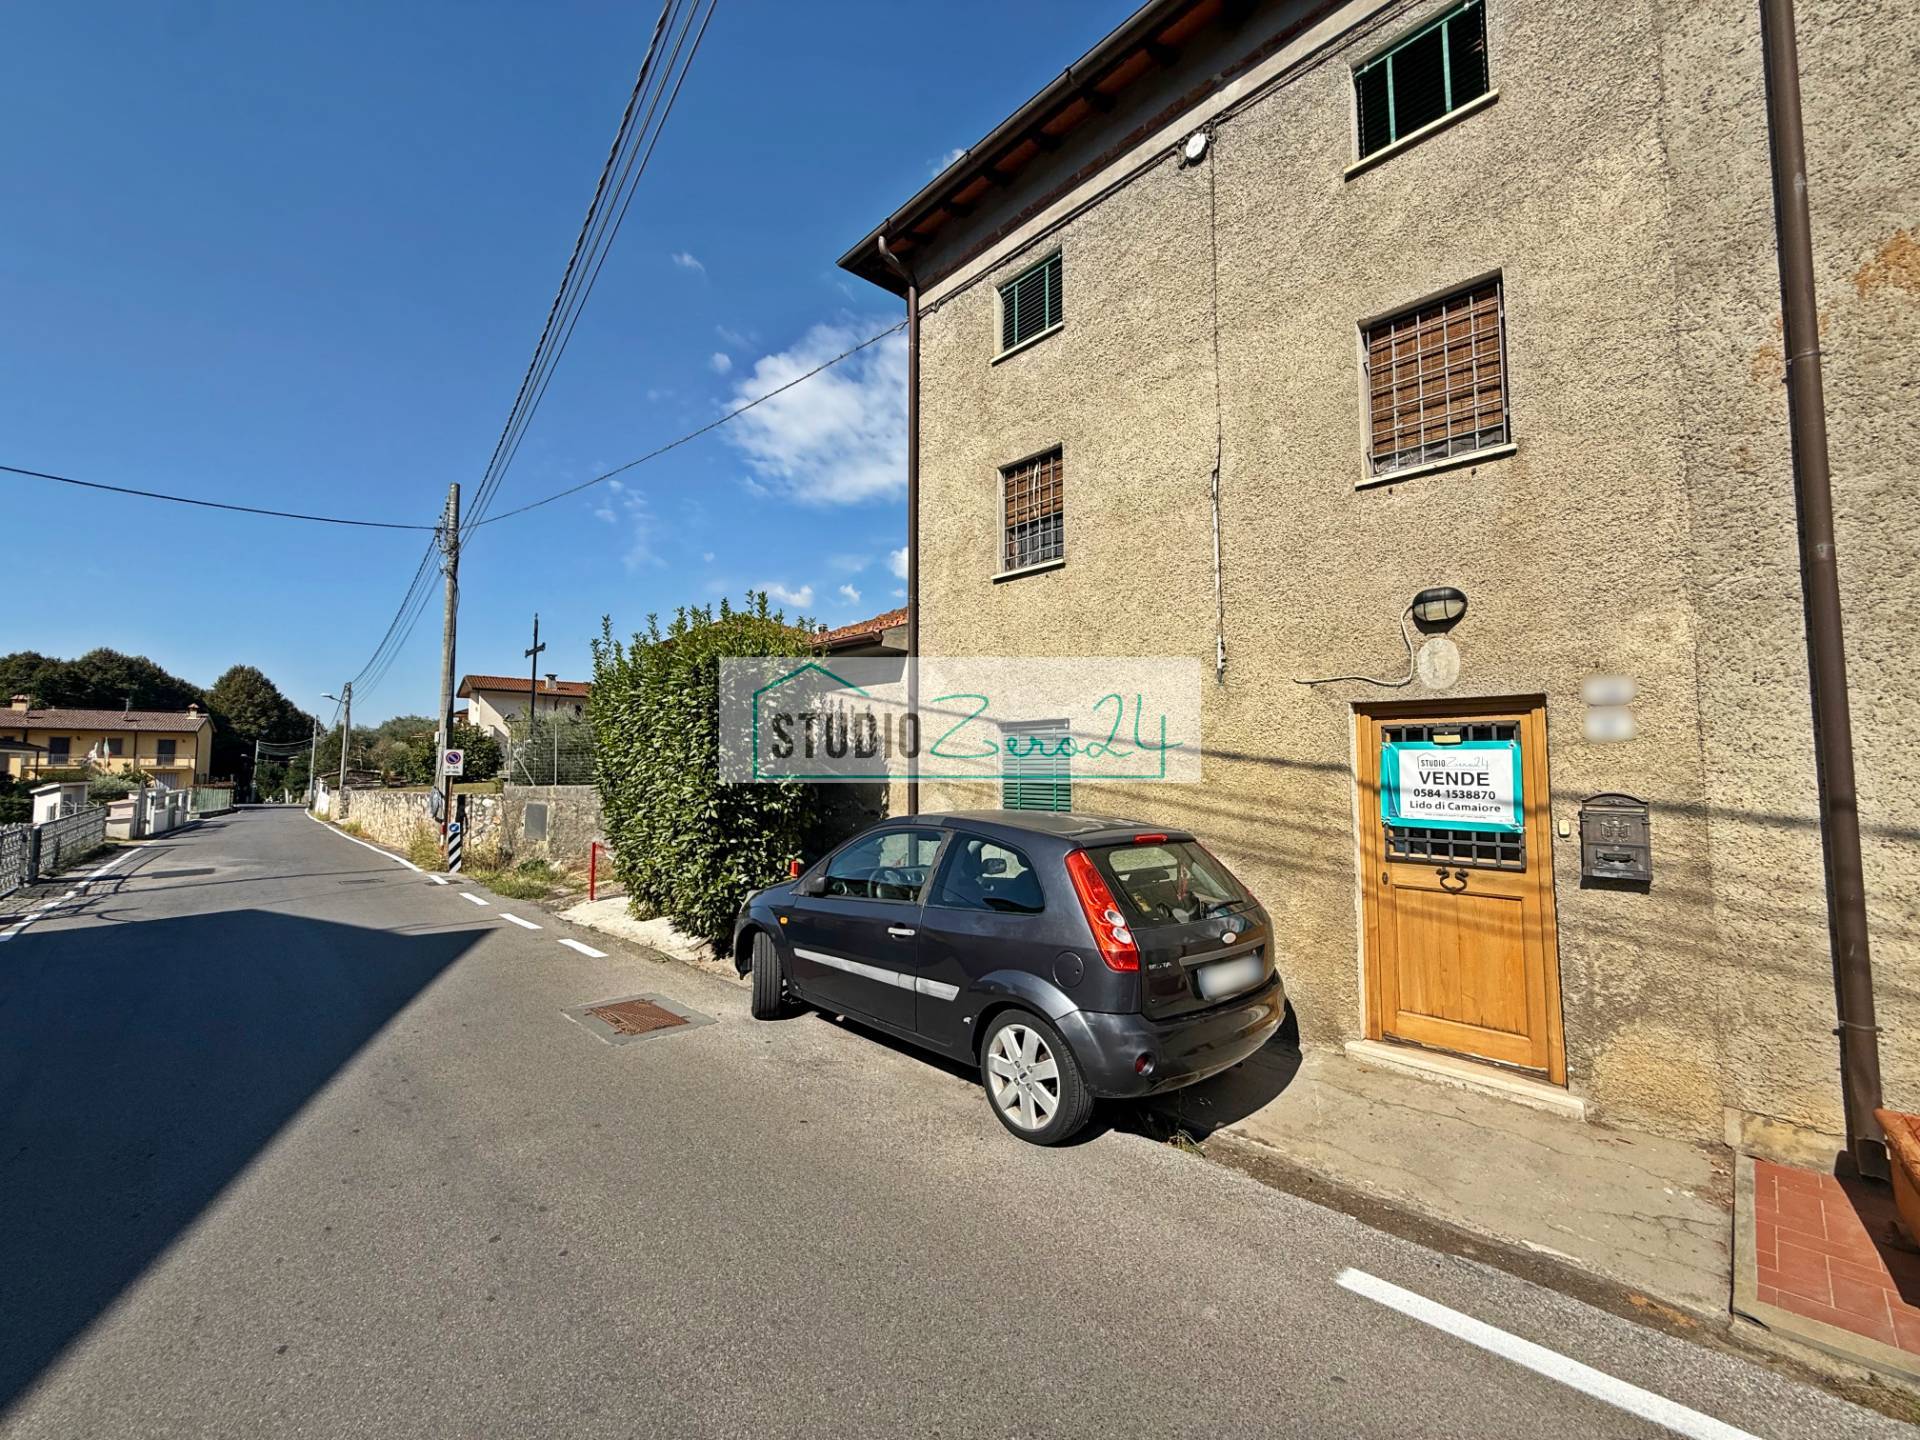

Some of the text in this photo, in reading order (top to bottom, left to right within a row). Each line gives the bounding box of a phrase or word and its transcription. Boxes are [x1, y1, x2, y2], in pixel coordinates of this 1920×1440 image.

[1420, 759, 1446, 767] STUDIO
[1419, 771, 1490, 786] VENDE
[1413, 788, 1496, 800] 0584 1538870
[1409, 801, 1501, 812] Lido di Camaiore
